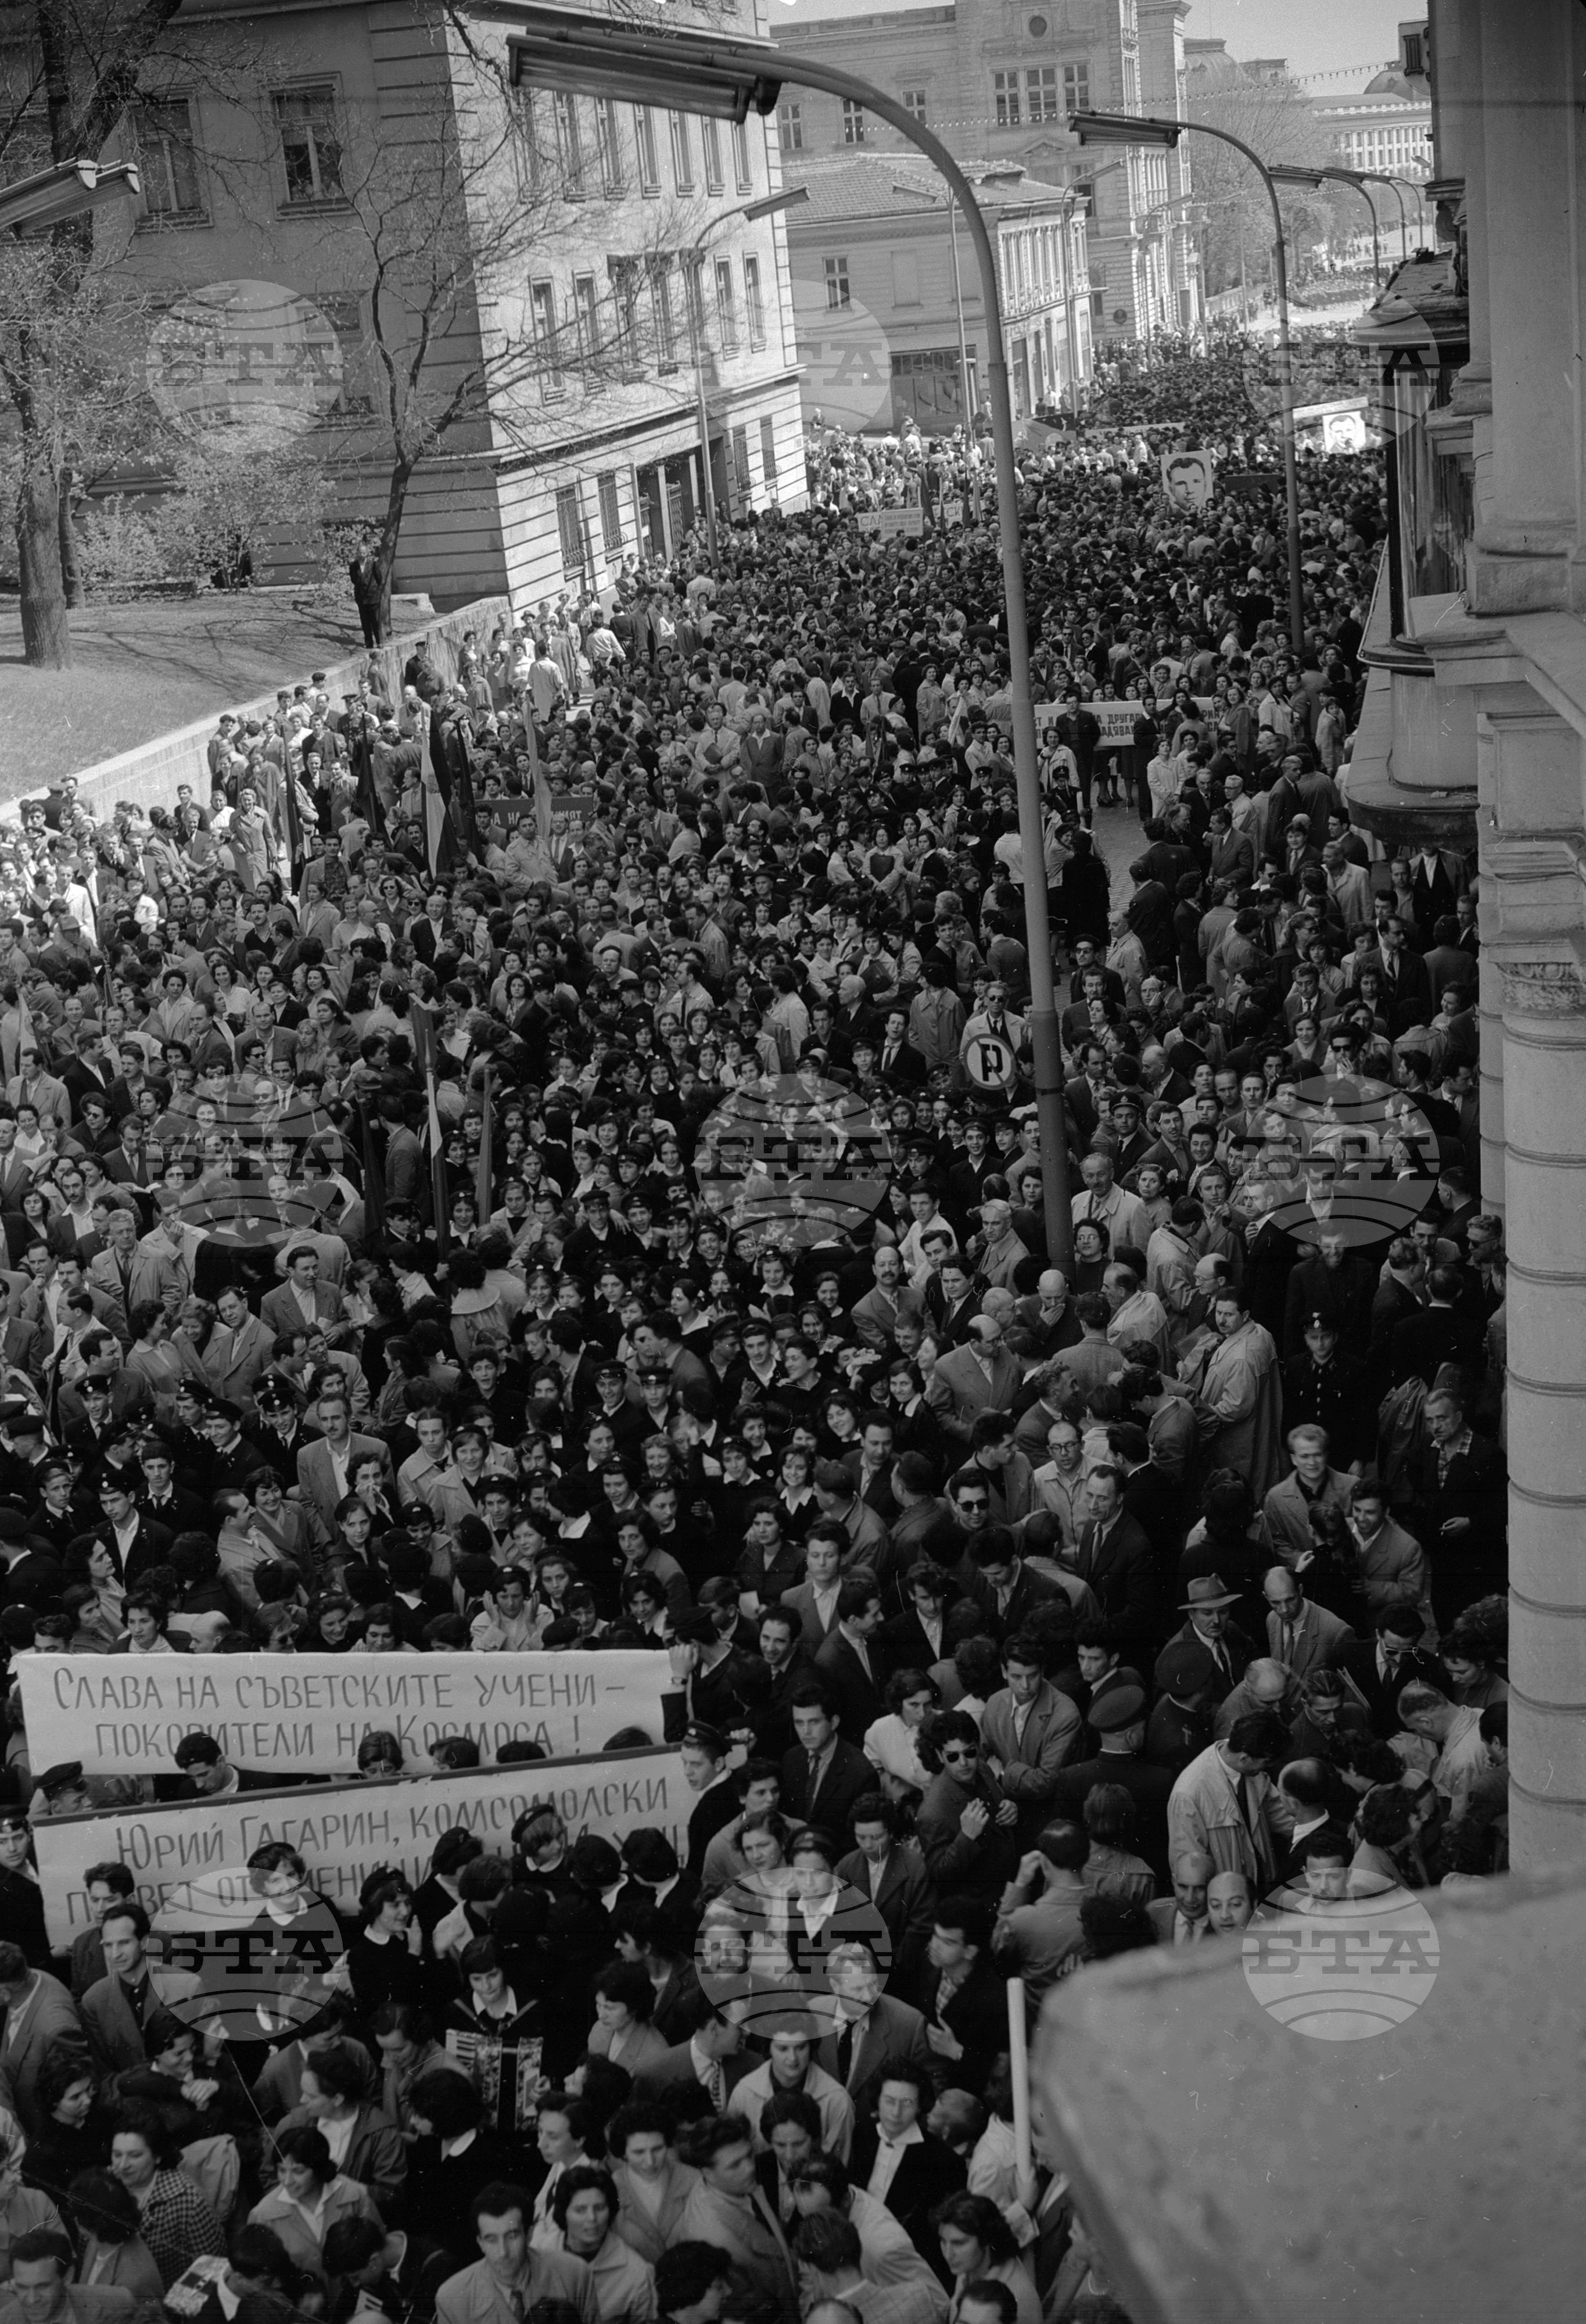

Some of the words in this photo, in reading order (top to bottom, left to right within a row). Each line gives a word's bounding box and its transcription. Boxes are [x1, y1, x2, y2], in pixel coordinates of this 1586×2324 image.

[54, 1667, 163, 1709] СЛАВА
[176, 1675, 220, 1709] НА
[235, 1674, 454, 1709] СЪВЕТСКИТЕ
[116, 1821, 224, 1870] ЮРИЙ
[66, 1880, 198, 1926] ПВЕТ
